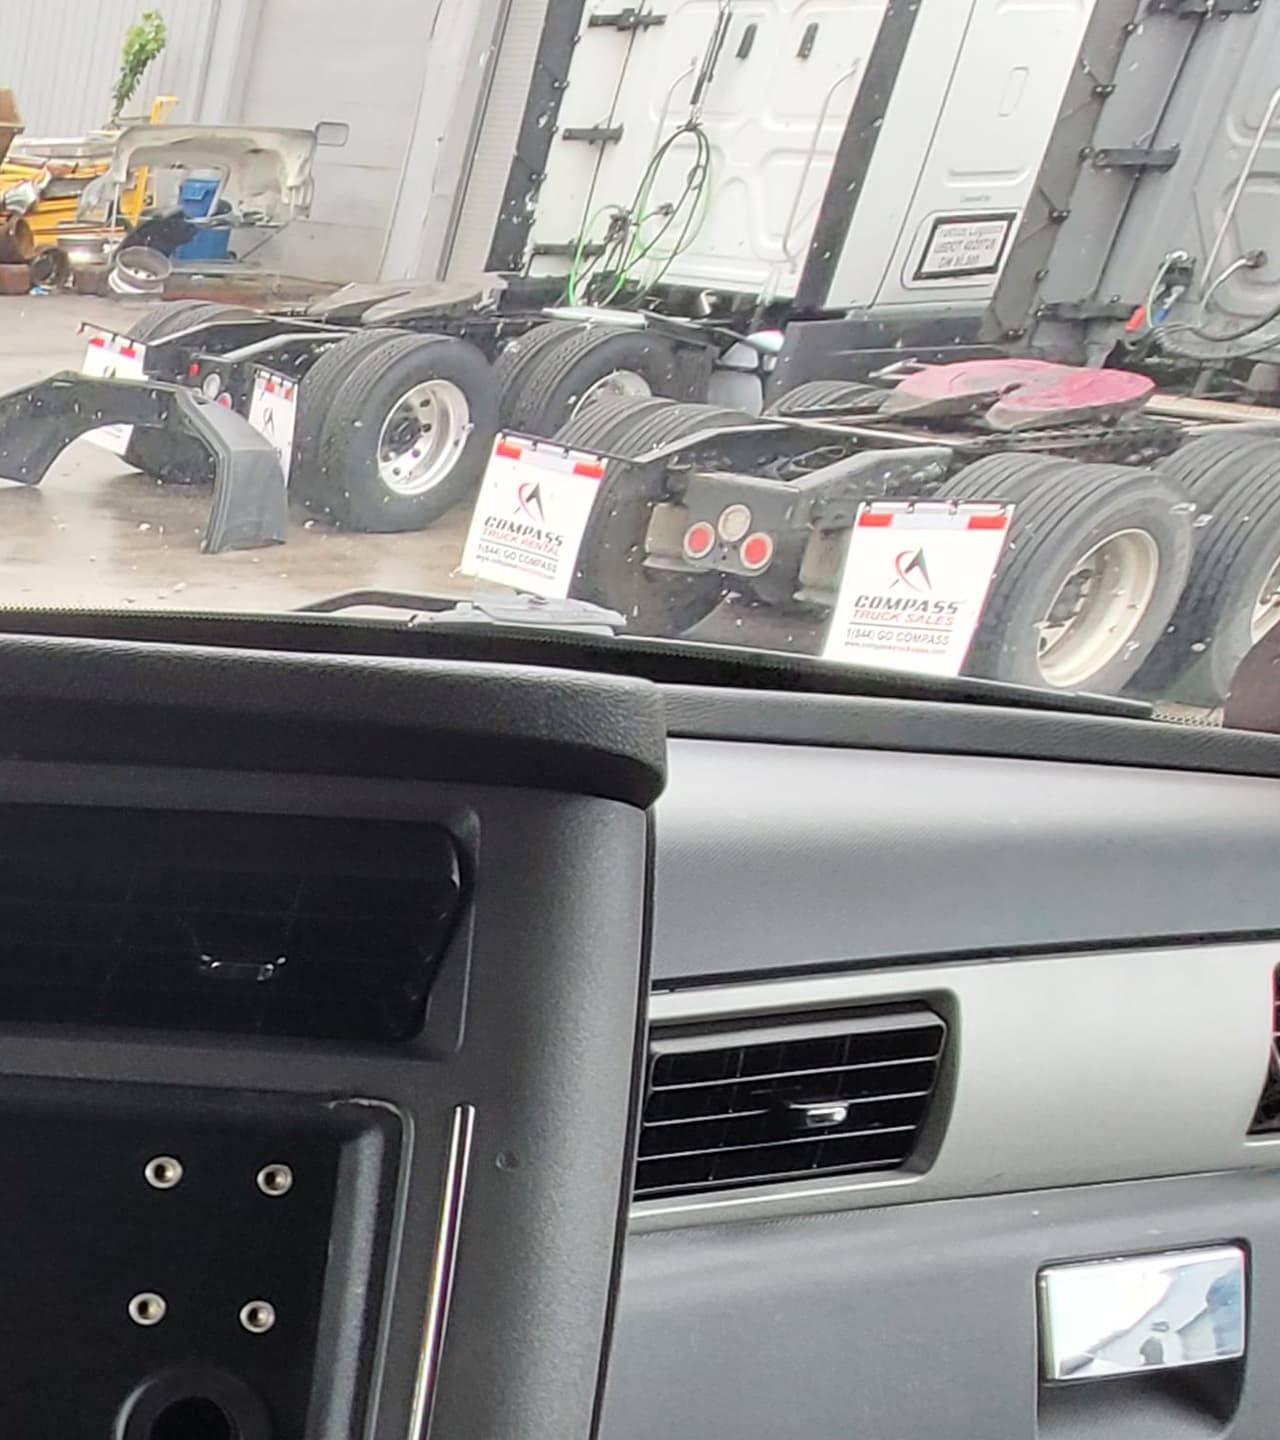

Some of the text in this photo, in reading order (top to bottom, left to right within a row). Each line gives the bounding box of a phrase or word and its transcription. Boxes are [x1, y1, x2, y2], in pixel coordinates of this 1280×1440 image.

[484, 516, 563, 547] COMPASS
[854, 594, 959, 614] COMPASS
[853, 609, 955, 626] TRUCK SALES
[877, 629, 894, 641] GO
[895, 631, 950, 646] COMPASS
